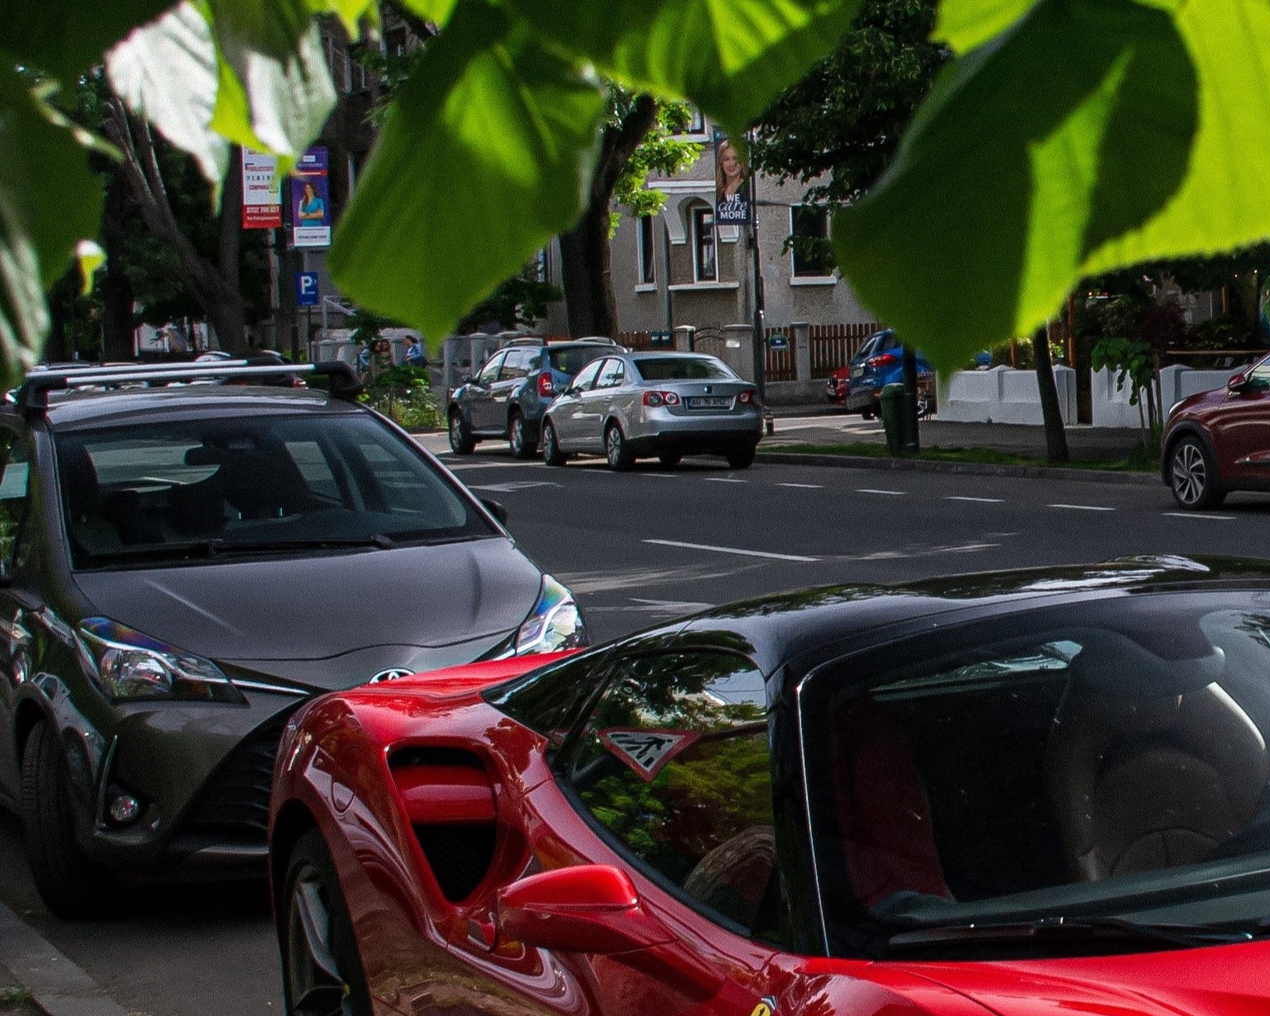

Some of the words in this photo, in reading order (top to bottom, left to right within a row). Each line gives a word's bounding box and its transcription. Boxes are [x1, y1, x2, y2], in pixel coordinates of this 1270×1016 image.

[726, 193, 741, 203] WE
[717, 202, 748, 212] care
[720, 211, 747, 220] MORE
[301, 275, 313, 295] P
